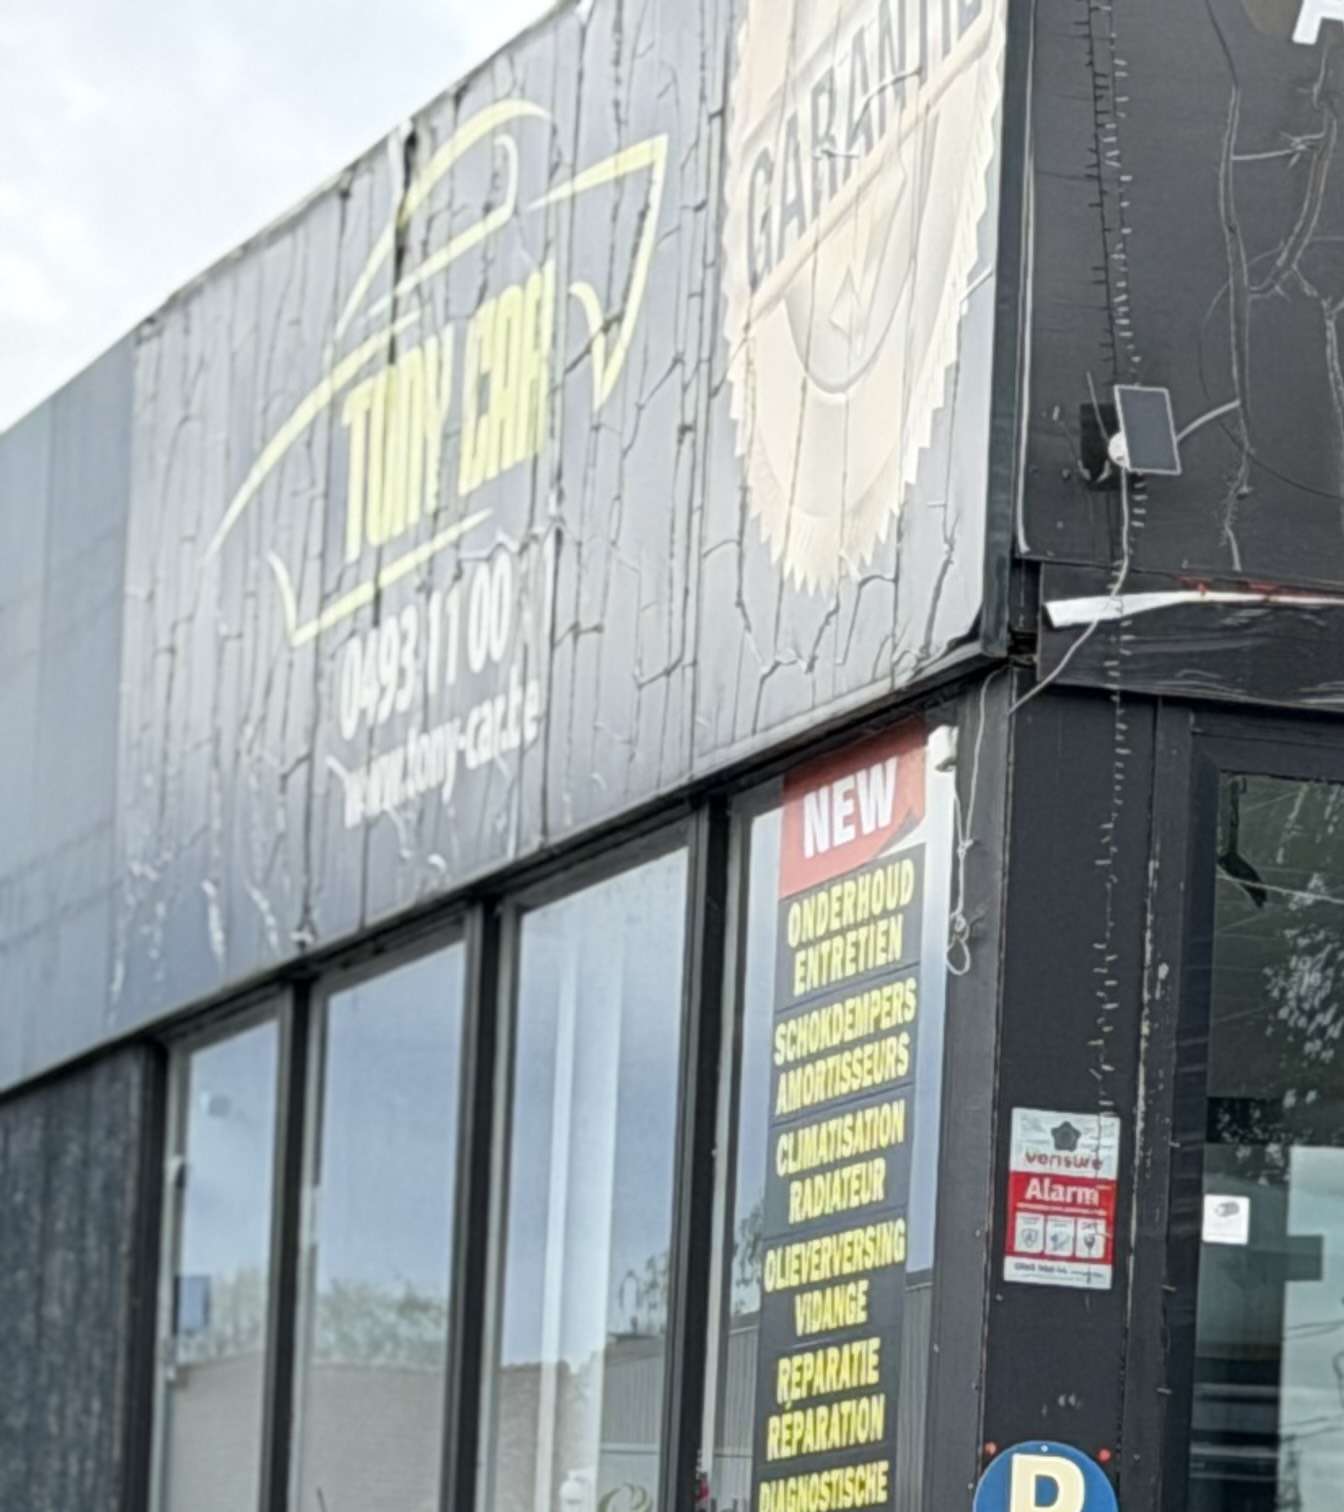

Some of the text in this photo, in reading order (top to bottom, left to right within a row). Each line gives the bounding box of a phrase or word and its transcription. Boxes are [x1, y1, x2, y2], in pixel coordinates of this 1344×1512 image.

[748, 0, 984, 293] GARAN
[803, 757, 897, 860] NEW
[787, 858, 915, 949] ONDERHOUD
[793, 914, 904, 996] ENTRETIEN
[773, 977, 917, 1067] SCHOKDEMPERS
[774, 1033, 911, 1117] AMORTISSEURS
[776, 1098, 906, 1179] CLIMATISATION
[788, 1157, 886, 1226] RADIATEUR
[1025, 1177, 1099, 1206] Alarm
[763, 1217, 908, 1294] OLIEVERVERSING
[795, 1279, 869, 1337] VIDANGE
[776, 1337, 882, 1404] REPARATIE
